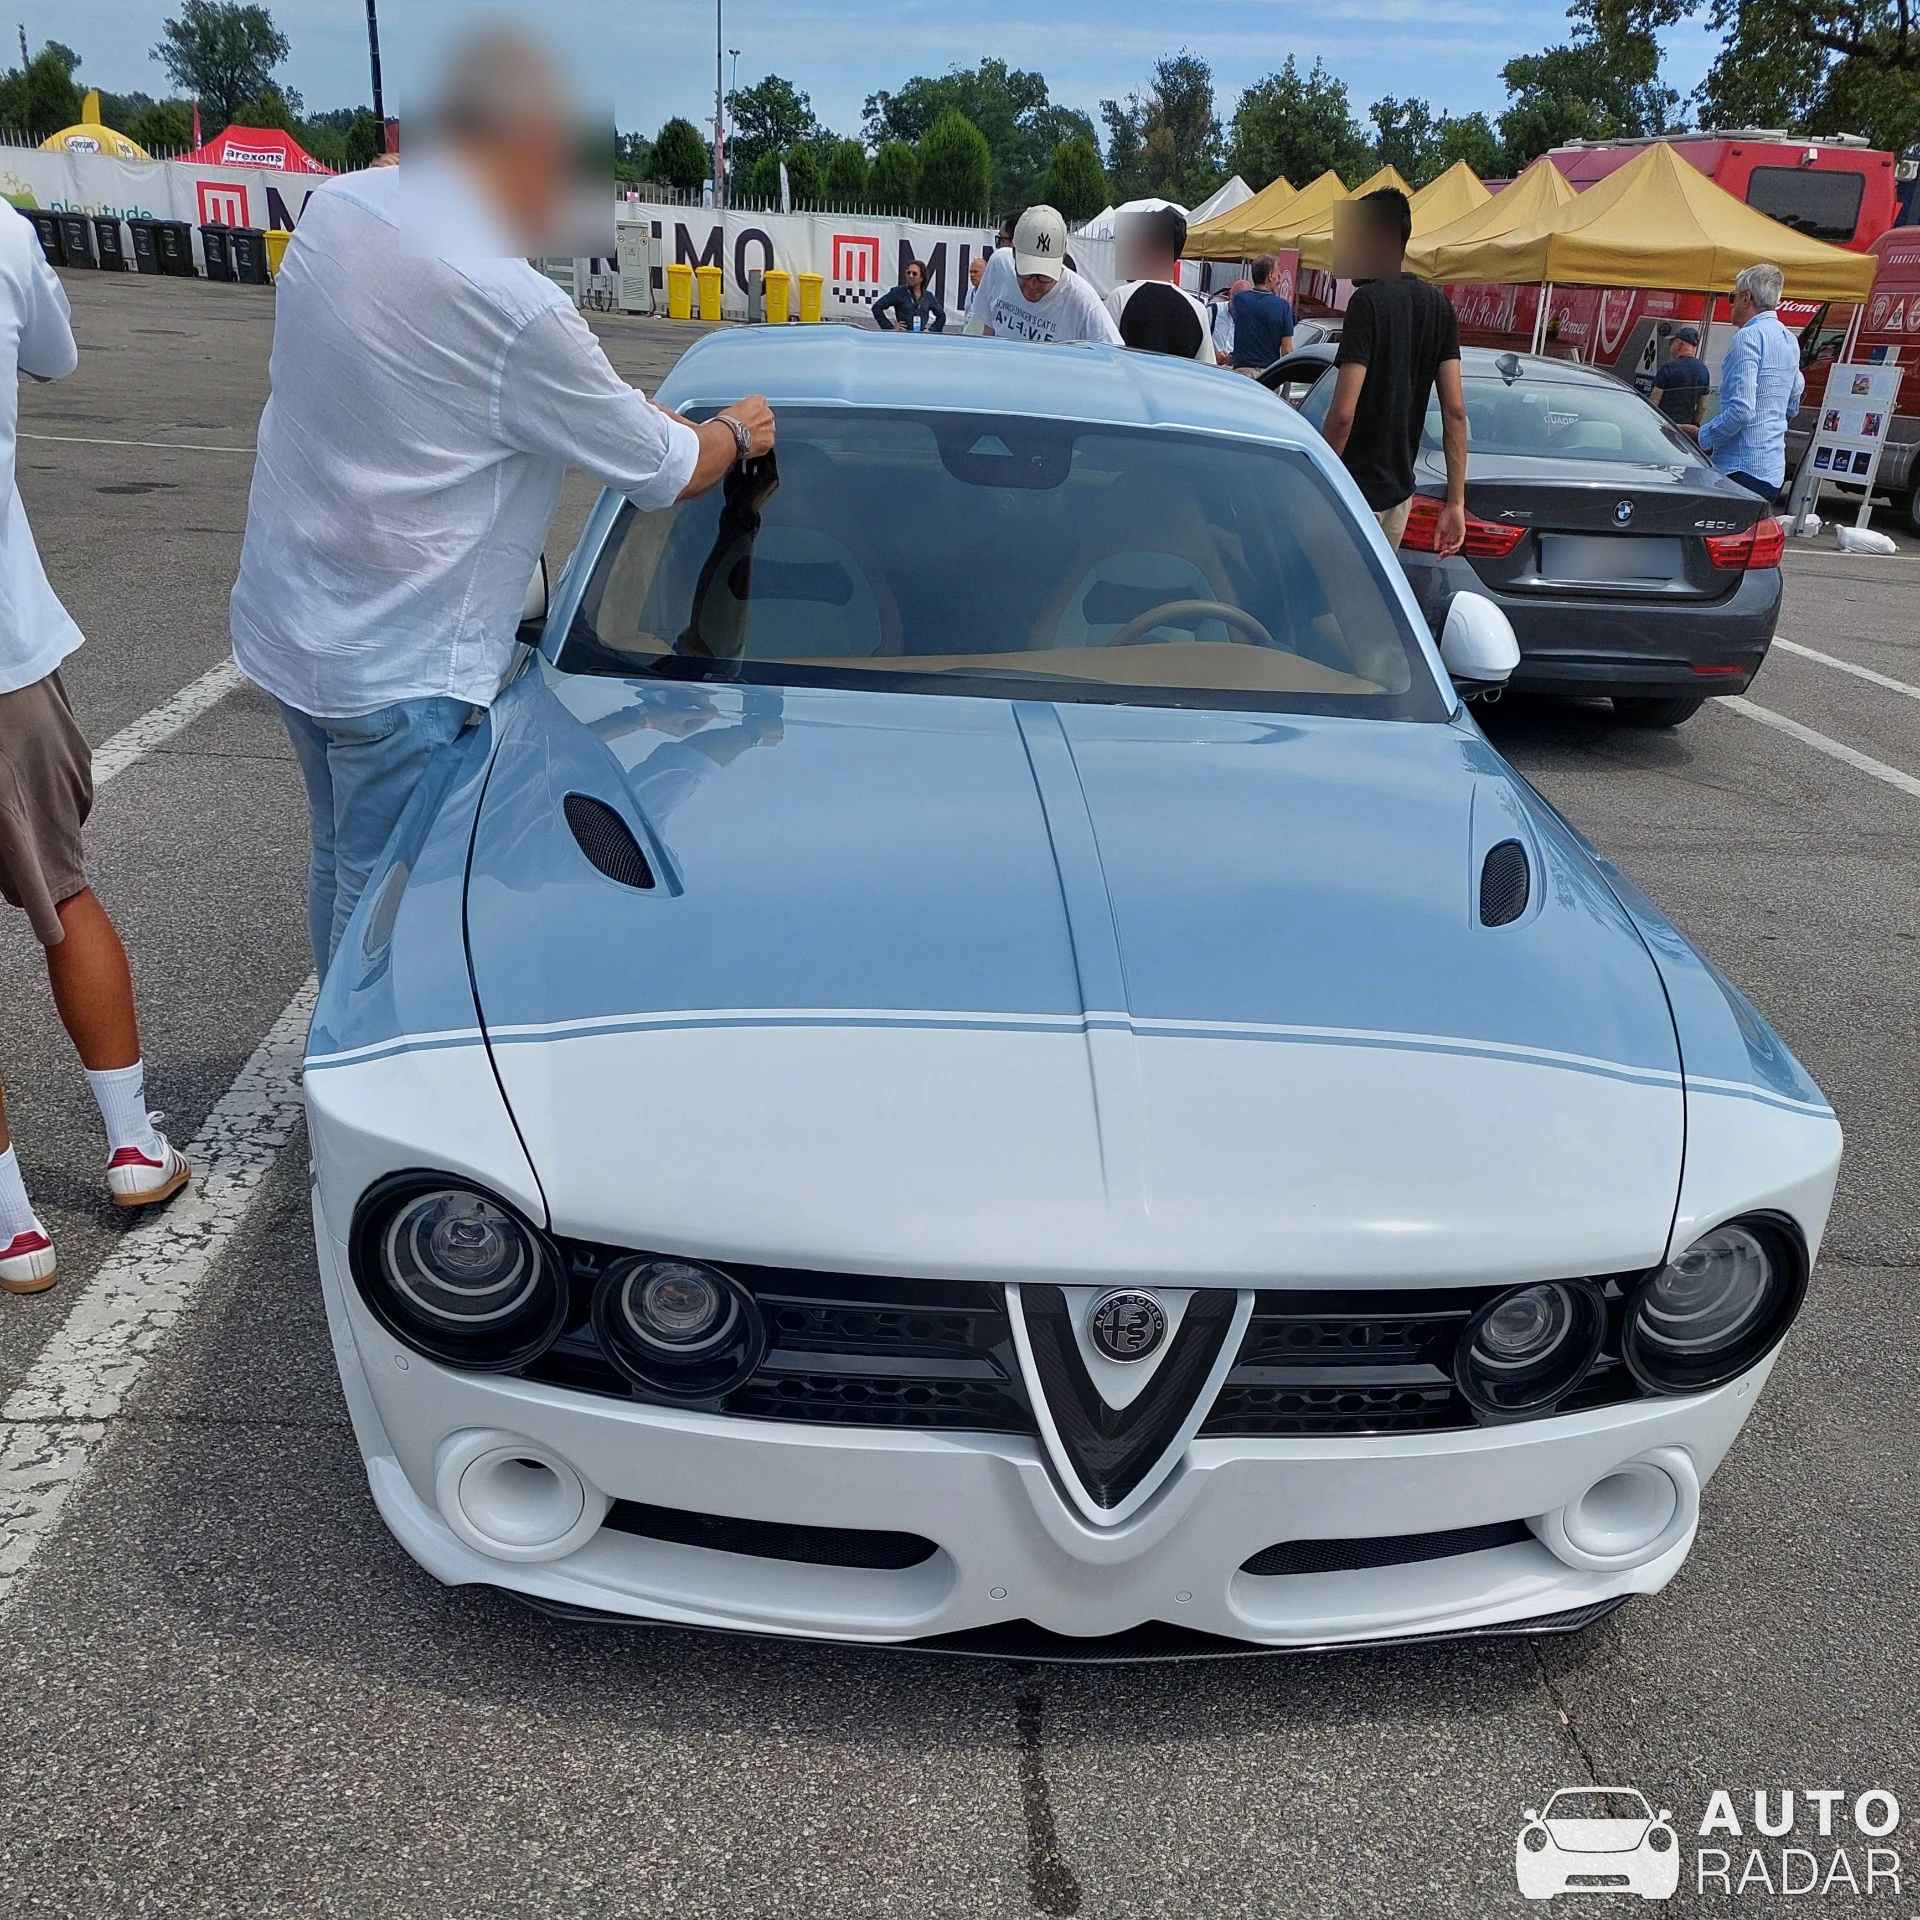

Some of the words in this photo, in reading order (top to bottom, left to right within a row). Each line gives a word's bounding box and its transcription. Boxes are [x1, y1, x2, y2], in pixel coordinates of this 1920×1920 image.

[226, 149, 283, 162] arexons
[50, 199, 153, 222] plenitude
[1036, 232, 1051, 252] NY
[1775, 300, 1822, 313] Rome
[1037, 318, 1052, 330] CAT
[1050, 322, 1057, 333] IS
[1095, 1299, 1120, 1328] ALFA
[1126, 1295, 1163, 1330] ROMEO
